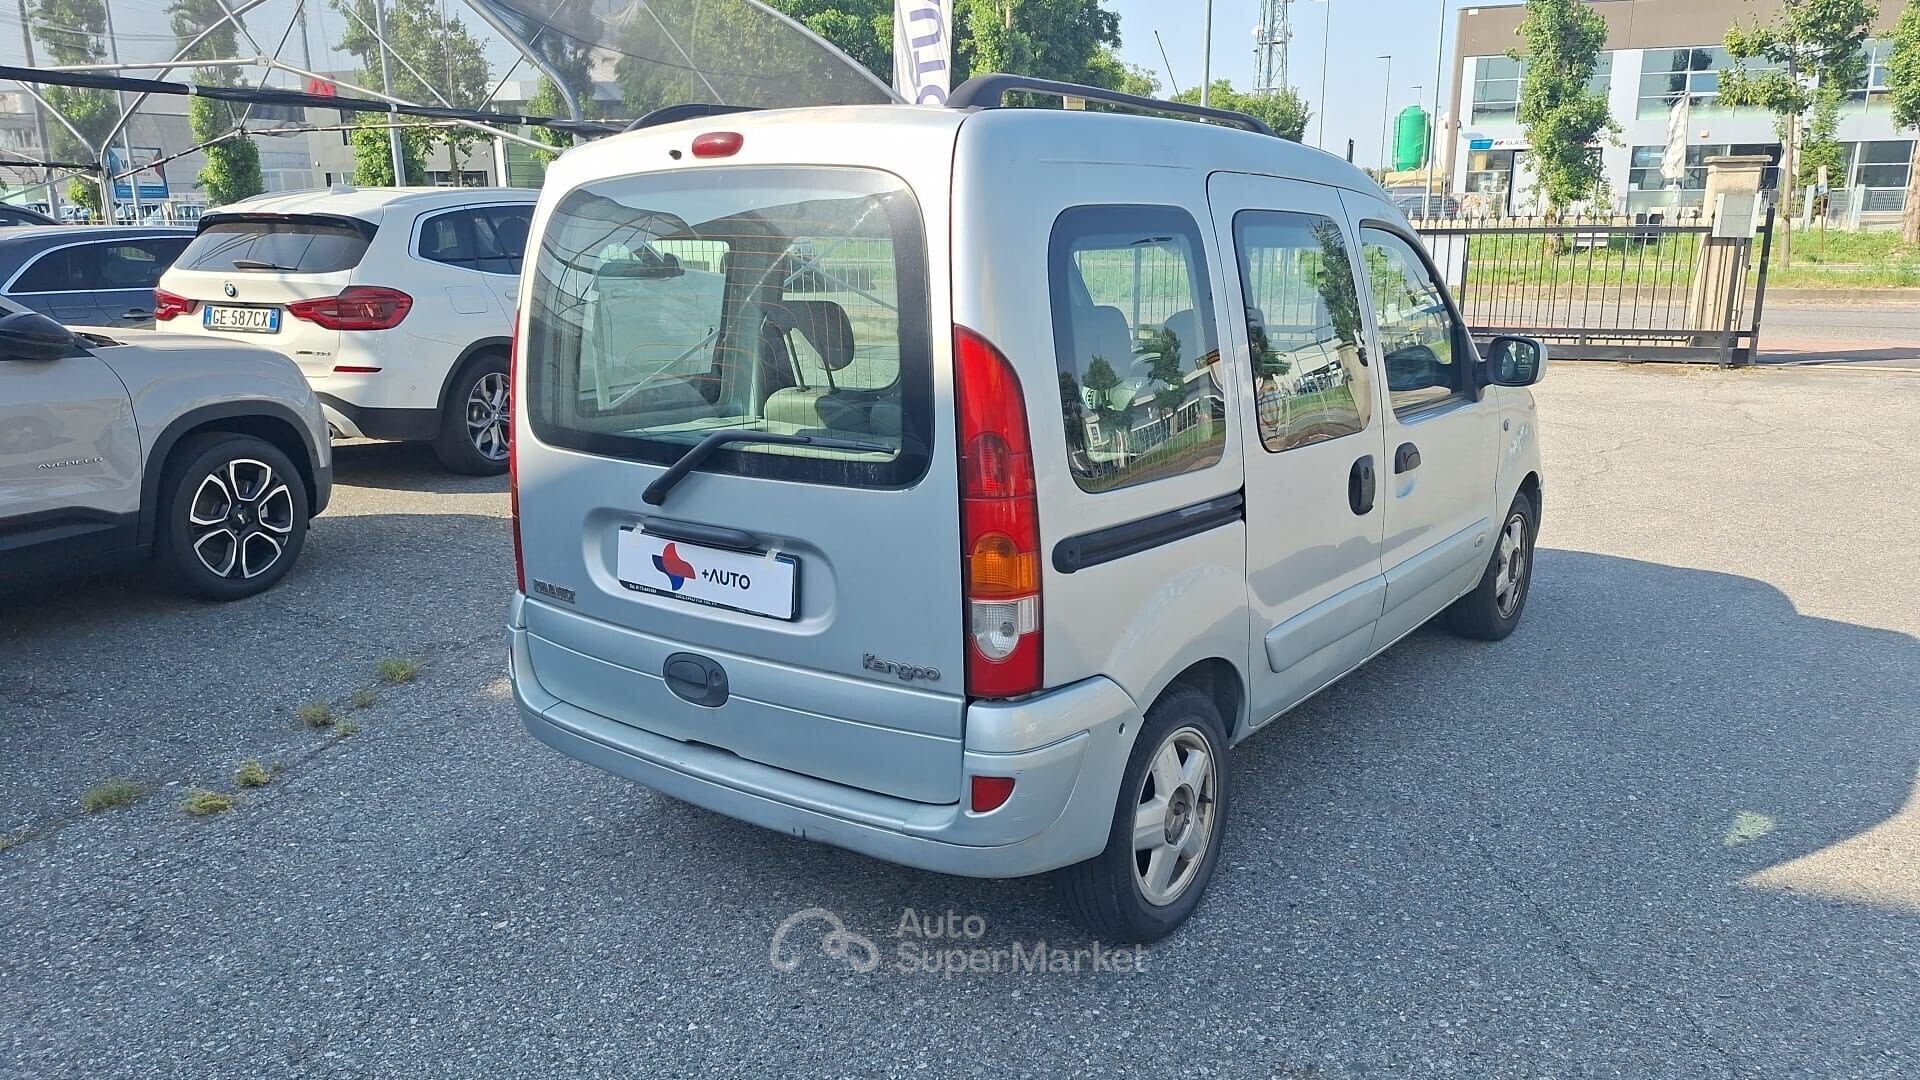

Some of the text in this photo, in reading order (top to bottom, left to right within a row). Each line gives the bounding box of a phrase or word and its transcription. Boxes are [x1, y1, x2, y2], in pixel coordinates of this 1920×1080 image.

[213, 309, 269, 327] GE 587CX
[37, 456, 104, 470] AVENGER
